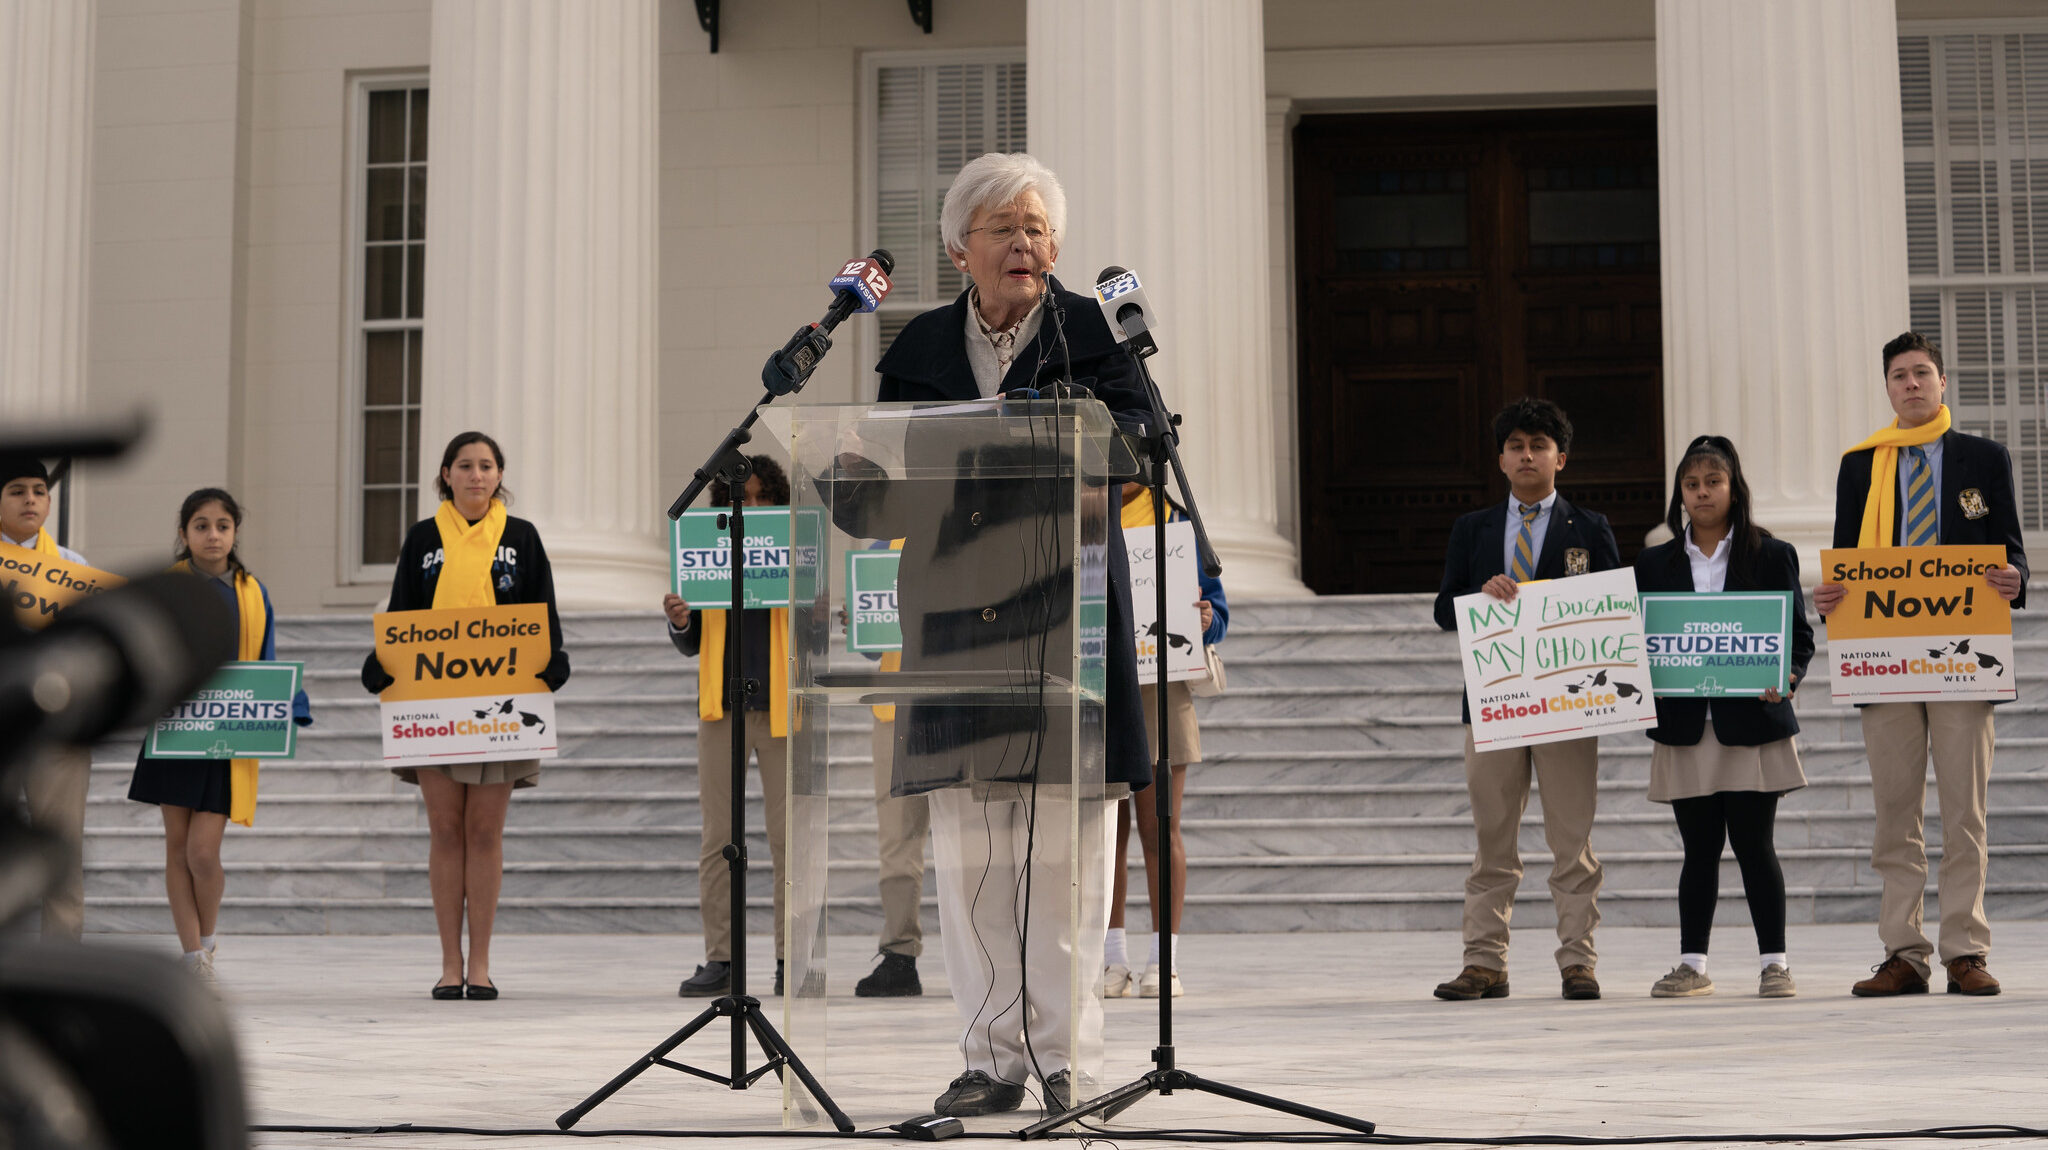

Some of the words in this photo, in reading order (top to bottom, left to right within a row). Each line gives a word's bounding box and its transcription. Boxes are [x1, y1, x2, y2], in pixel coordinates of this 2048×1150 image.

[842, 261, 867, 275] 12
[833, 276, 855, 284] WSFA
[865, 266, 888, 299] 12
[1096, 273, 1132, 290] WAKA
[857, 279, 877, 308] WSFA
[716, 536, 774, 548] STONG
[1832, 559, 1912, 582] School
[1919, 558, 1999, 578] Choic
[1864, 586, 1974, 619] Now!
[1468, 598, 1522, 633] MY
[384, 620, 460, 645] School
[466, 618, 541, 639] Choice
[1683, 621, 1743, 633] STRONG
[1646, 636, 1779, 653] STUDENTS
[1472, 636, 1525, 676] MY
[1535, 633, 1639, 669] CHOICE
[1705, 655, 1780, 667] ALABAMA
[1841, 651, 1892, 660] NATIONAL
[414, 647, 517, 681] Now!
[198, 689, 254, 700] STRONG
[1480, 691, 1531, 705] NATIONAL
[392, 712, 440, 722] NATIONAL
[1584, 706, 1617, 718] WEEK
[157, 721, 215, 731] STRONG
[217, 721, 288, 732] ALABAMA
[489, 734, 520, 742] WEEK
